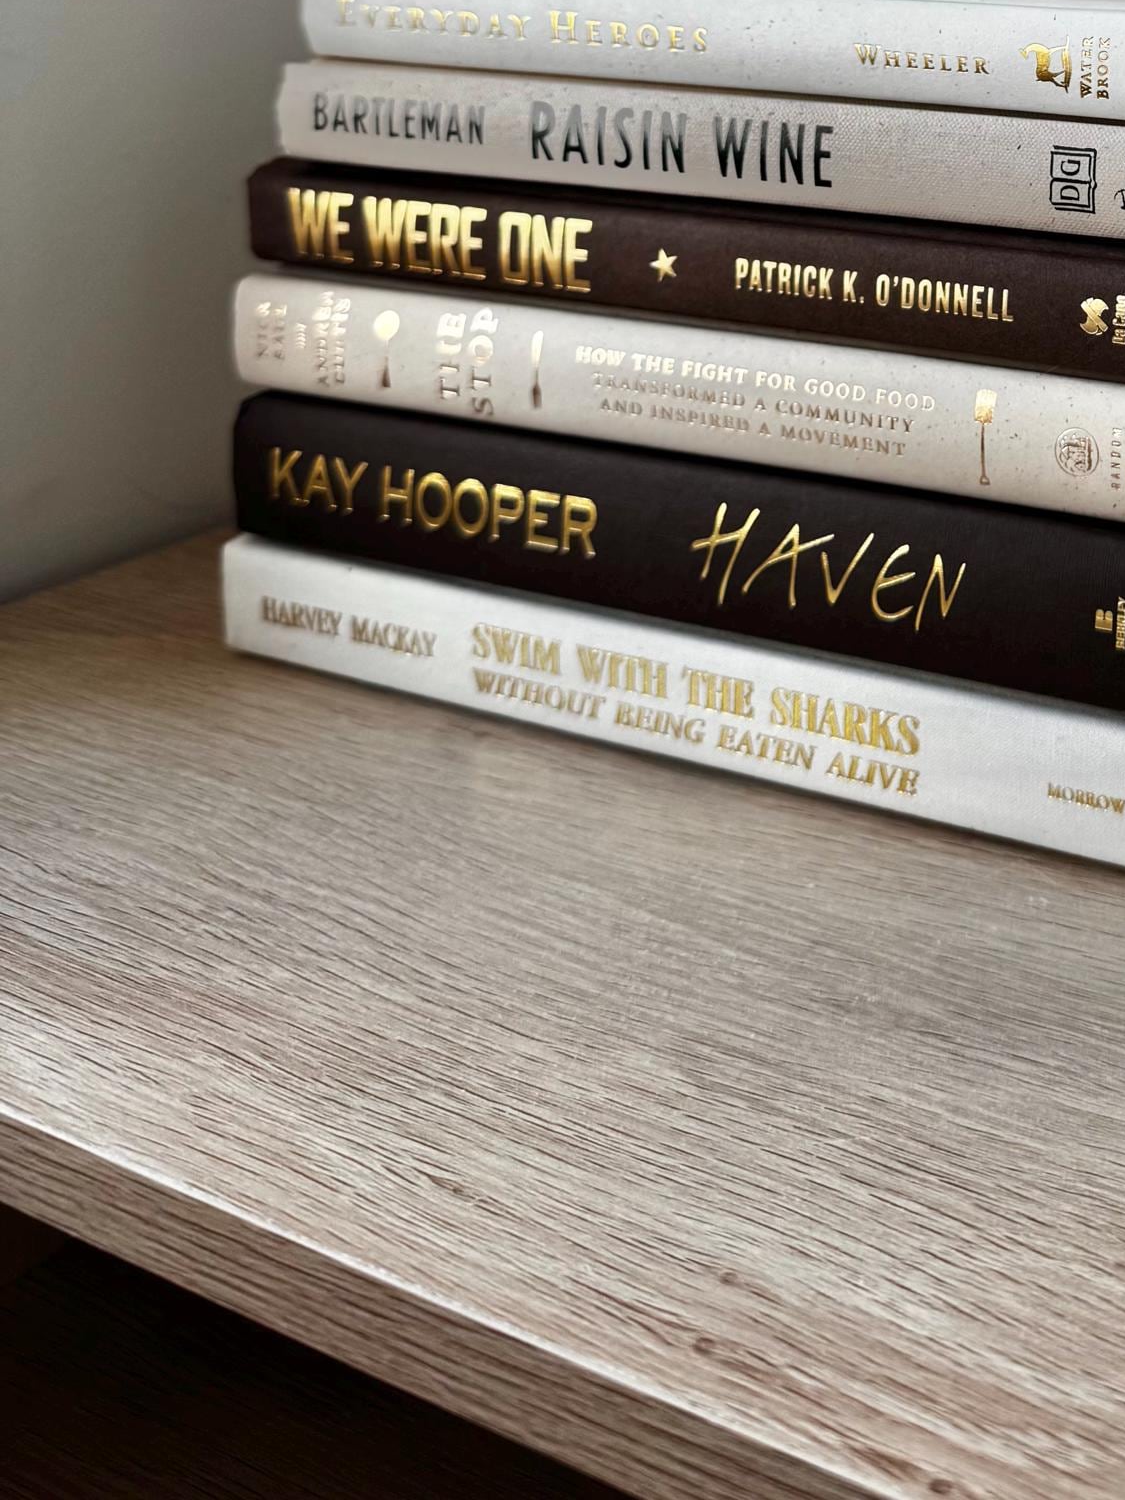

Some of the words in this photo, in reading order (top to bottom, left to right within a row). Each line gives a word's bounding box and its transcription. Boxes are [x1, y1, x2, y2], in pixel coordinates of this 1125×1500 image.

[1080, 35, 1094, 98] WATER
[1097, 37, 1111, 99] BROOK
[312, 93, 485, 145] BARTLEMAN
[531, 101, 687, 173] RAISIN
[713, 115, 834, 188] WINE
[287, 188, 354, 262] WE
[363, 195, 487, 280] WERE
[500, 210, 593, 293] ONE
[735, 257, 833, 302] PATRICK
[842, 271, 865, 304] K.
[876, 273, 1014, 323] O'DONNELL
[468, 308, 499, 416] STOP
[575, 346, 626, 366] HOW
[631, 353, 674, 375] THE
[681, 360, 748, 384] FIGHT
[755, 370, 796, 391] FOR
[804, 378, 866, 401] GOOD
[875, 387, 935, 411] FOOD
[592, 372, 745, 407] TRANSFORMED
[754, 397, 768, 411] A
[776, 399, 915, 432] COMMUNITY
[600, 398, 642, 416] AND
[651, 404, 749, 432] INSPIRED
[758, 422, 772, 436] A
[780, 425, 906, 456] MOVEMENT
[1111, 427, 1123, 490] RANDOM
[267, 447, 368, 515] KAY
[377, 465, 598, 559] HOOPER
[690, 501, 967, 632] HAVEN
[262, 595, 343, 637] HARVEY
[351, 614, 438, 657] MACKAY
[471, 621, 562, 676] SWIM
[576, 644, 668, 699] WITH
[683, 667, 755, 719] THE
[769, 686, 921, 756] SHARKS
[472, 666, 606, 719] WITHOUT
[614, 701, 705, 743] BEING
[717, 724, 817, 770] EATEN
[826, 751, 921, 796] ALIVE
[1046, 781, 1125, 815] MORROW
